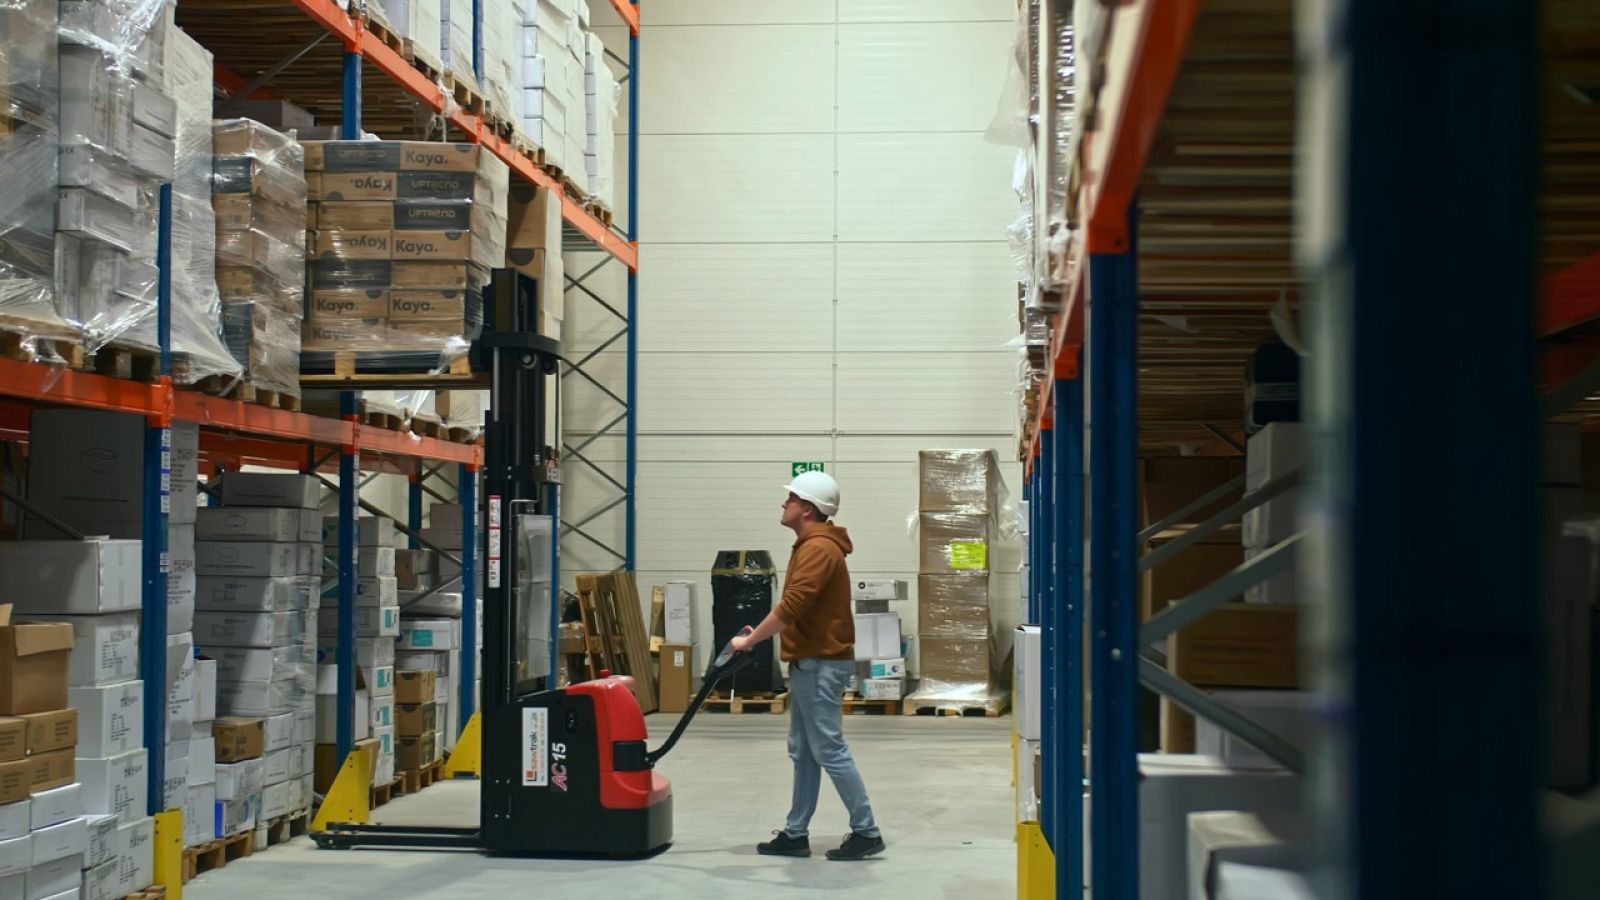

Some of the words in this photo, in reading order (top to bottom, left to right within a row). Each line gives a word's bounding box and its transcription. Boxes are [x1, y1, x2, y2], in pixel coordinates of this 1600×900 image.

[405, 151, 449, 167] Kaya.
[350, 178, 392, 191] Kaya.
[408, 209, 456, 218] UPTREND
[396, 240, 438, 255] Kaya.
[316, 299, 360, 314] Kaya.
[392, 299, 435, 314] Kaya.
[551, 742, 566, 761] 15
[551, 763, 567, 792] AC
